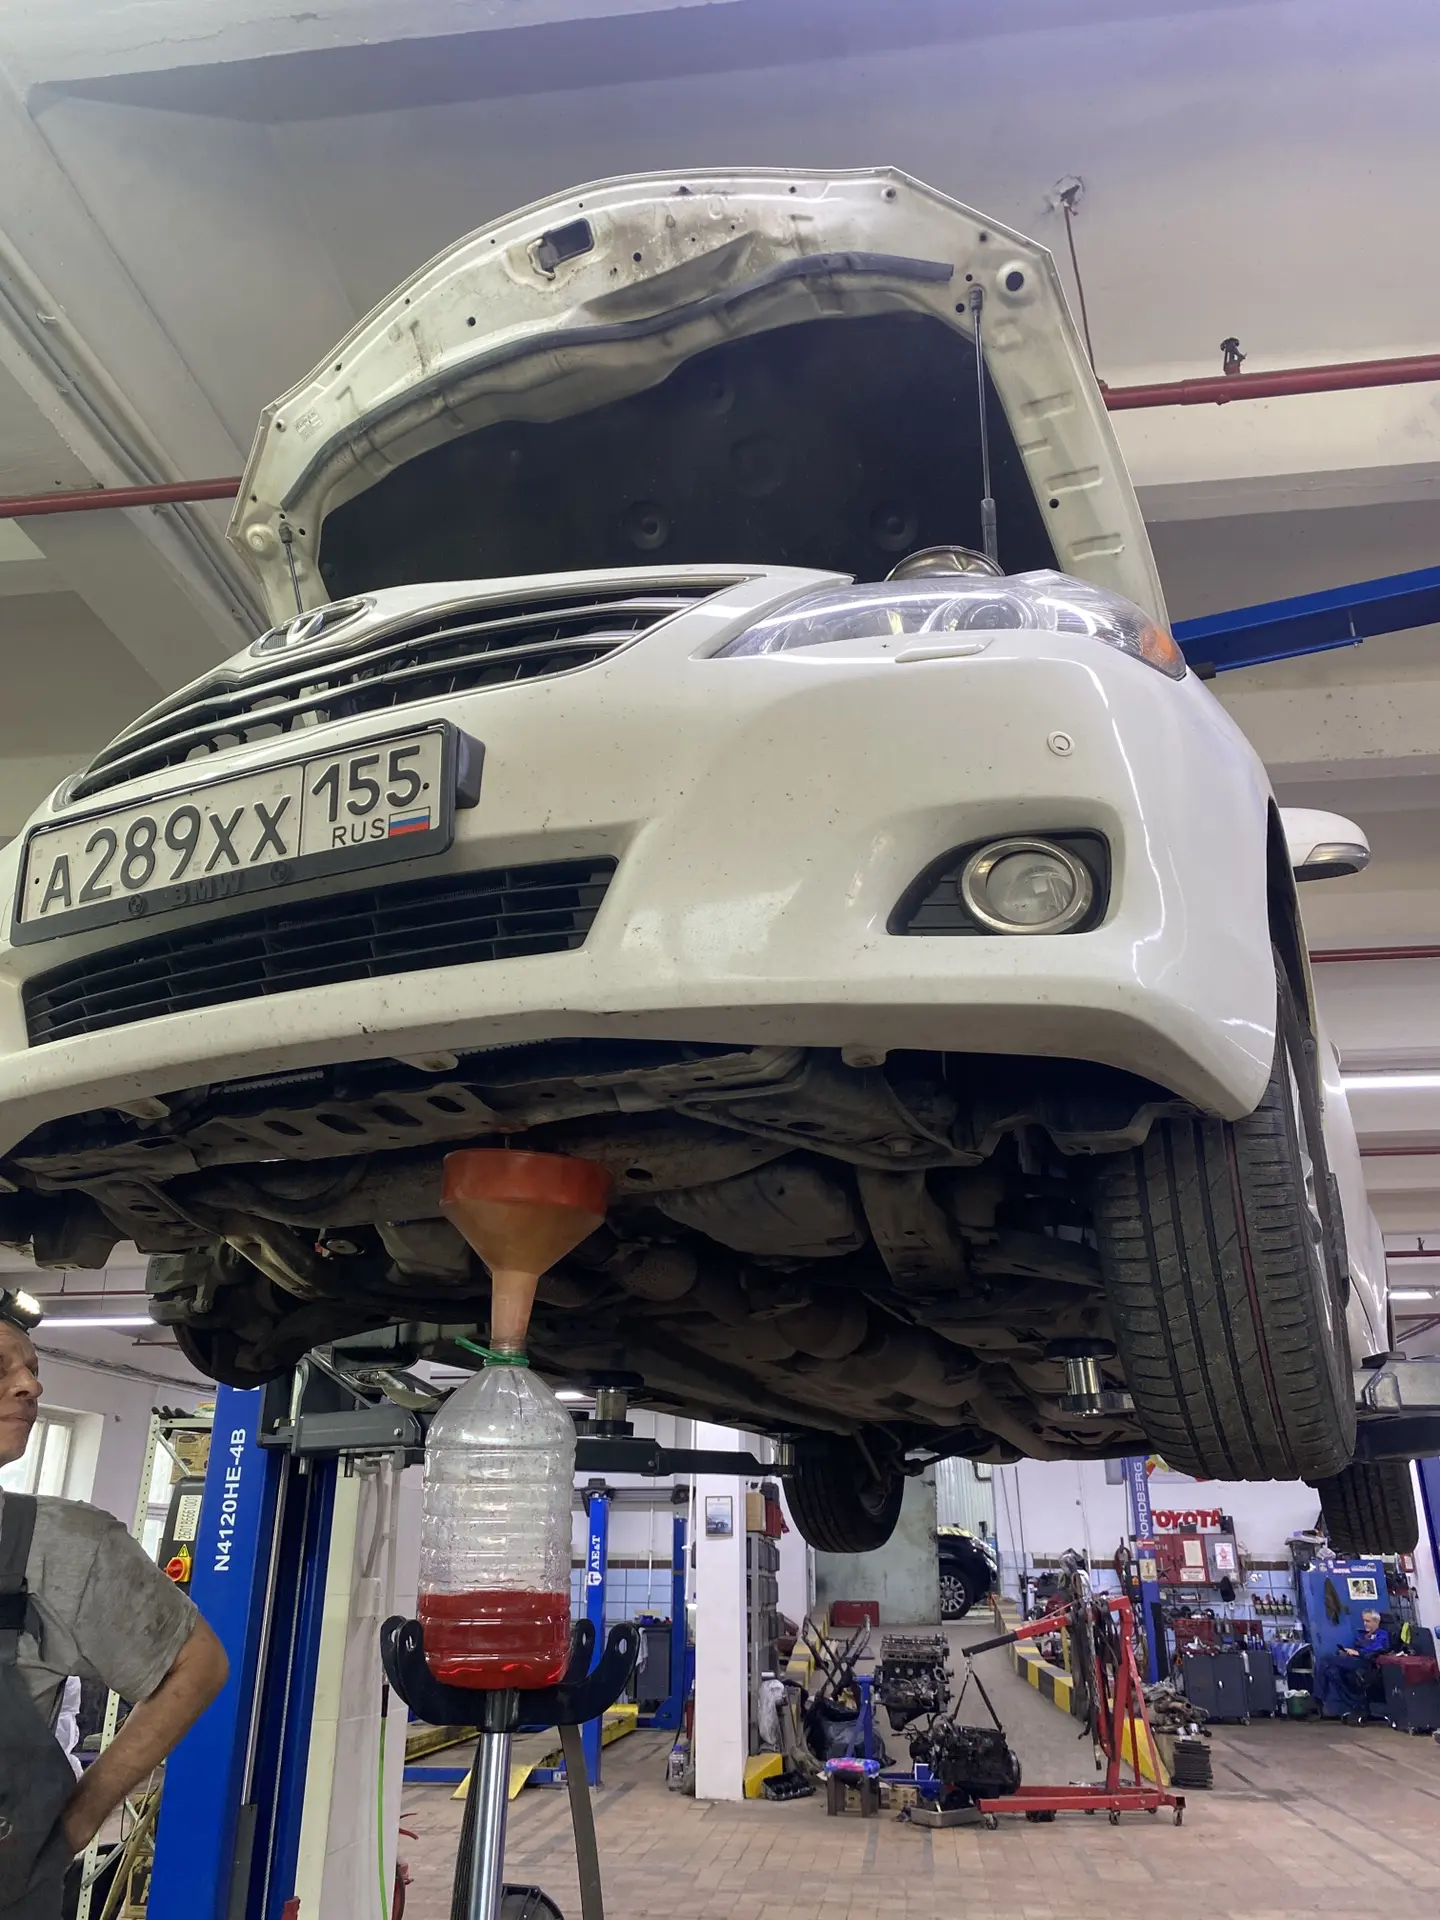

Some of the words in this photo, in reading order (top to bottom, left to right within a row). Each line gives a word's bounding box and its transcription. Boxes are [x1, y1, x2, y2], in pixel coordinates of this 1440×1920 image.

[310, 744, 422, 822] 155
[39, 794, 292, 914] A289XX
[331, 816, 385, 848] RUS
[213, 1428, 246, 1572] N4120HE-4B
[1133, 1462, 1150, 1539] NORDBERG
